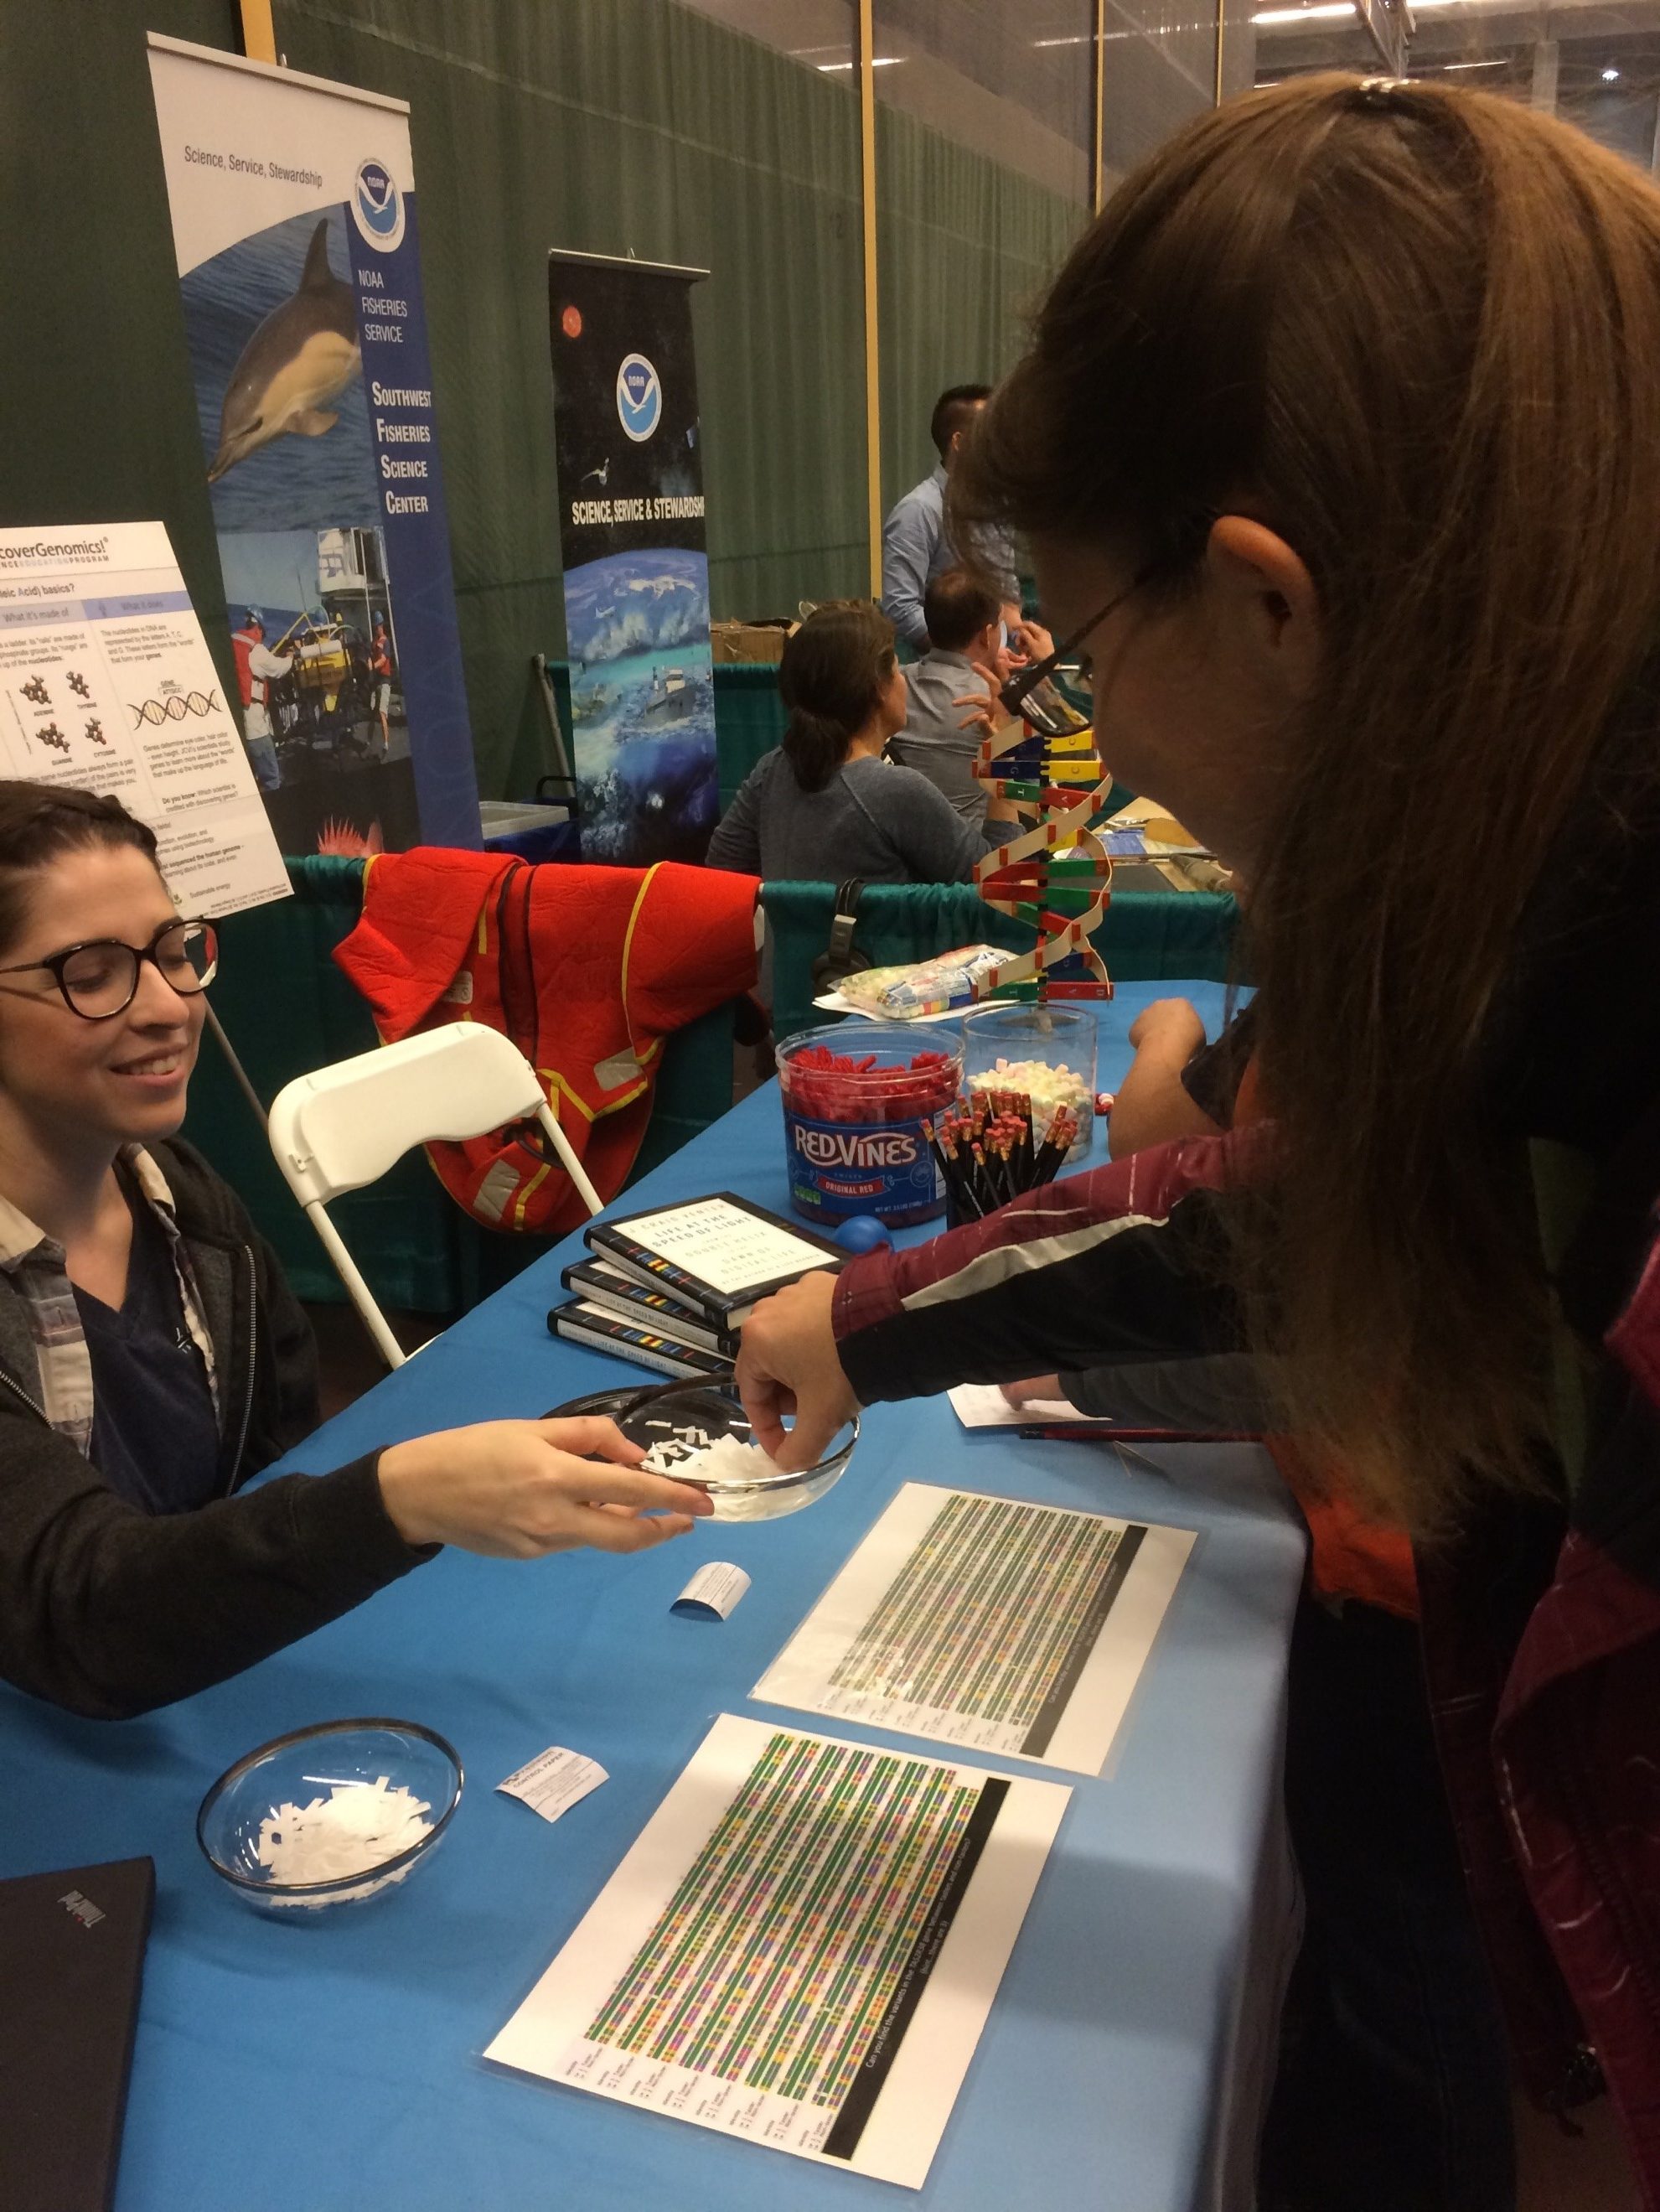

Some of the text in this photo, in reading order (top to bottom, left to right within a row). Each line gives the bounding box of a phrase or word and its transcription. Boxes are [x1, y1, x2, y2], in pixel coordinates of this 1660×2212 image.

[184, 145, 323, 189] Science, Service, Stewardship
[358, 269, 385, 288] NOAA
[361, 296, 407, 317] FISHERIES
[365, 324, 404, 343] SERVICE
[371, 381, 432, 407] SOUTHWEST
[376, 417, 431, 443] FISHERIES
[380, 453, 428, 479] SCIENCE
[385, 490, 430, 515] CENTER
[571, 500, 613, 528] SCIENCE,
[613, 498, 644, 522] SERVICE
[645, 498, 653, 520] &
[18, 586, 42, 597] Acid)
[42, 583, 75, 594] basics?
[825, 1181, 857, 1194] ORIGINAL
[859, 1184, 874, 1194] RED
[652, 1216, 752, 1247] SPEED OF LIGHT
[654, 1213, 727, 1238] LIFE AT THE
[542, 1752, 564, 1769] PAPER
[904, 1966, 915, 1980] the
[892, 1987, 907, 2013] variants
[886, 2013, 895, 2027] the
[877, 2026, 890, 2040] find
[874, 2039, 884, 2054] you
[866, 2052, 877, 2068] Can
